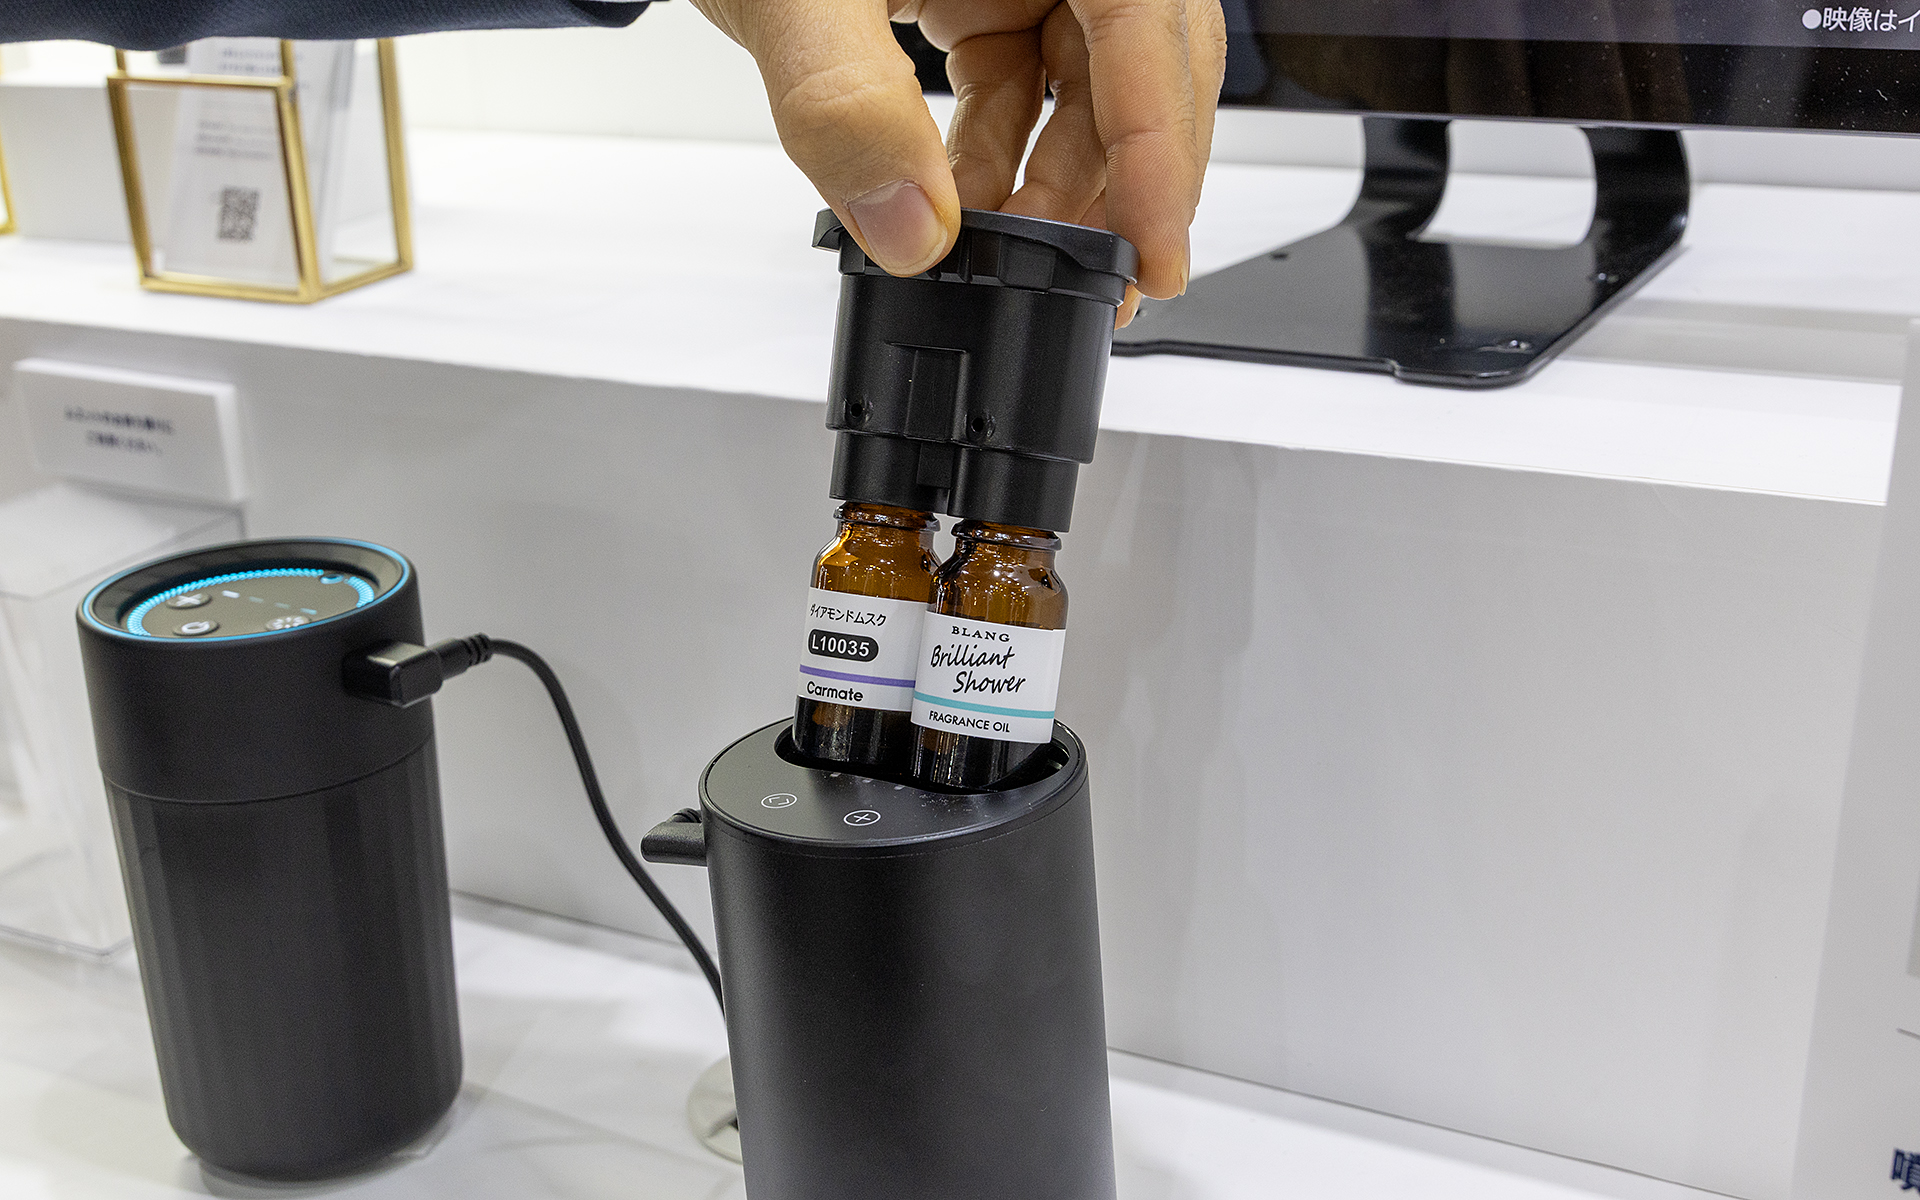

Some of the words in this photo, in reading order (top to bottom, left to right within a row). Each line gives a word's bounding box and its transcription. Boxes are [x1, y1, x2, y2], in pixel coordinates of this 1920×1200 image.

[809, 603, 887, 626] ダイアモンドムスク
[811, 633, 871, 657] L10035
[951, 625, 1011, 643] BLANG
[930, 643, 1015, 670] Brilliant
[806, 680, 864, 702] Carmate
[952, 670, 1026, 694] Shower
[928, 710, 990, 731] FRAGRANCE
[992, 721, 1011, 733] OIL
